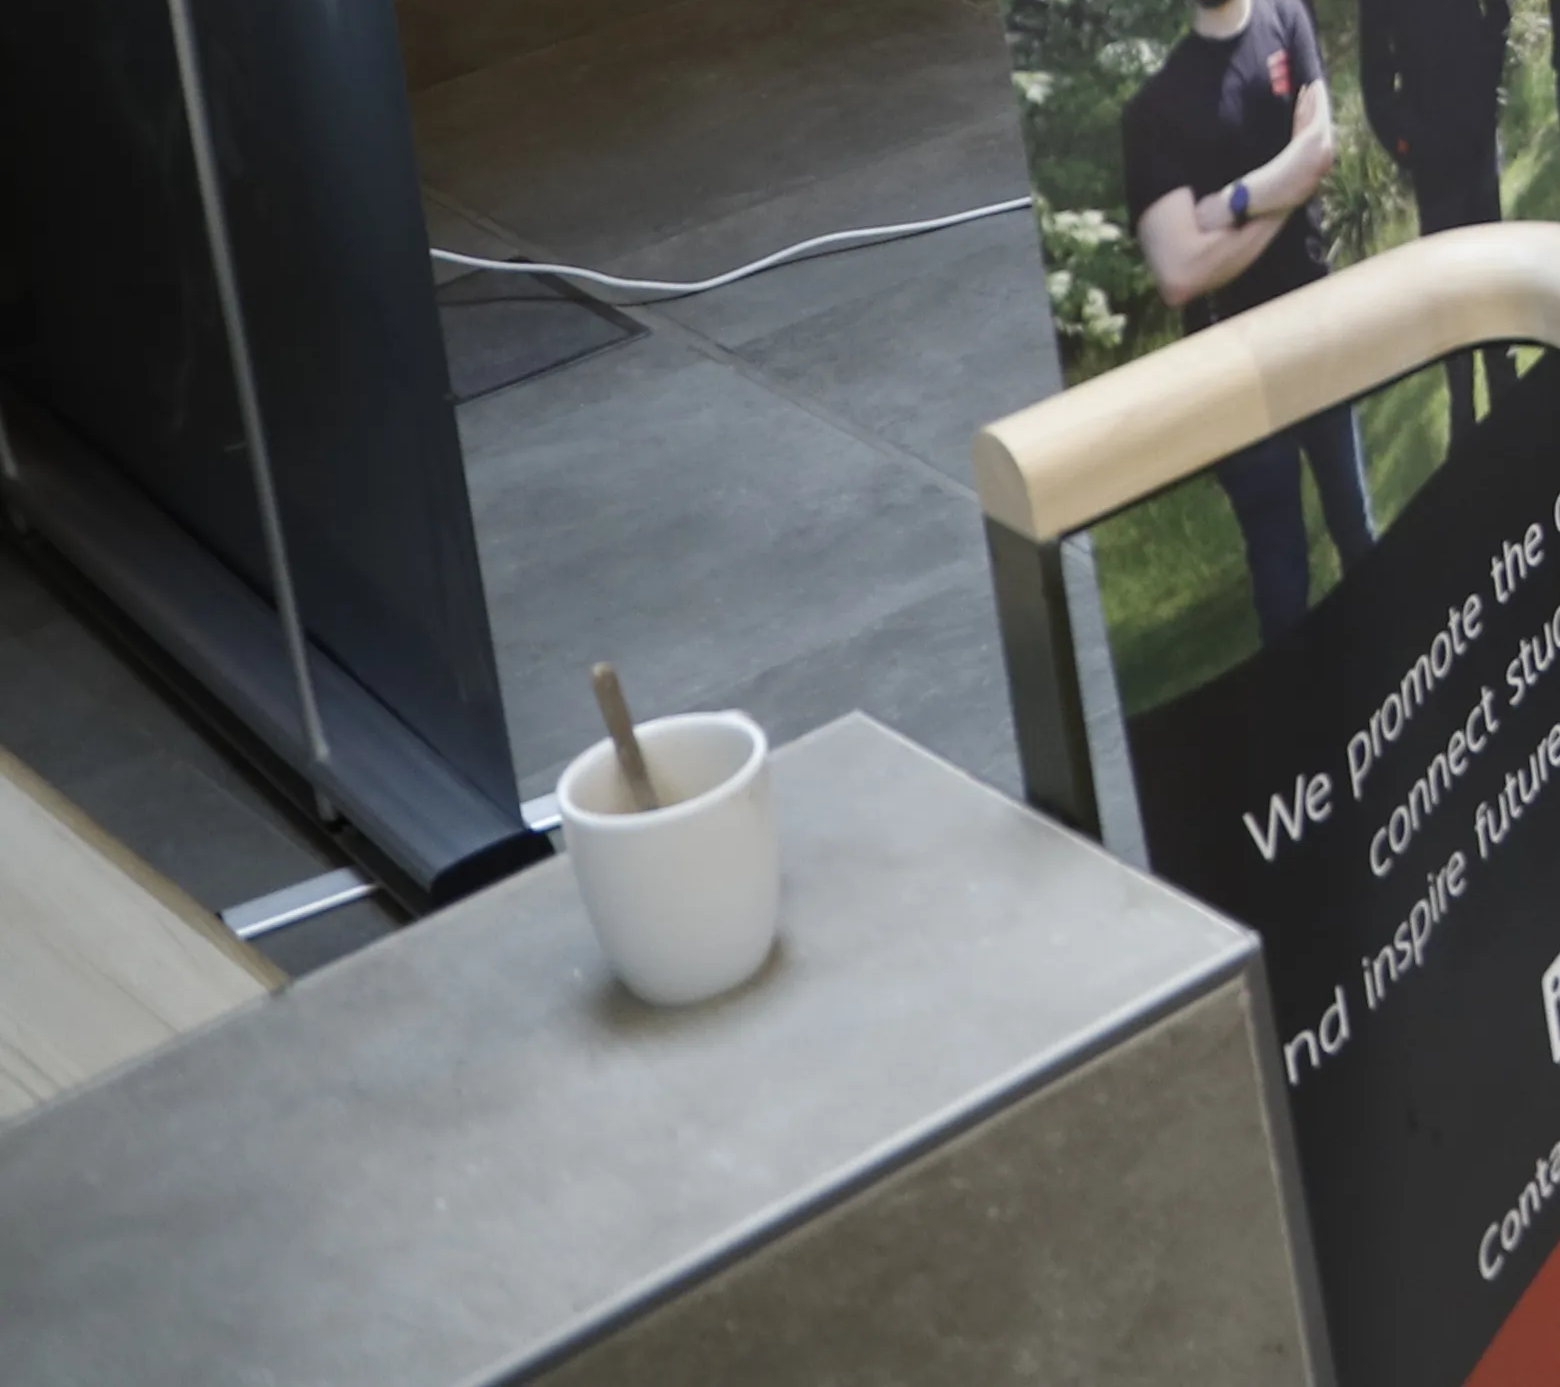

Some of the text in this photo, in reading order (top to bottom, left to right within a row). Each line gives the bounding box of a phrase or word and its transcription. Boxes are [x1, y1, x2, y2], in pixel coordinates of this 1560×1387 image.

[1242, 771, 1335, 863] We
[1345, 591, 1485, 802] promote
[1490, 522, 1545, 605] the
[1368, 685, 1500, 879] connect
[1282, 989, 1351, 1087] nd
[1361, 849, 1468, 1012] inspire
